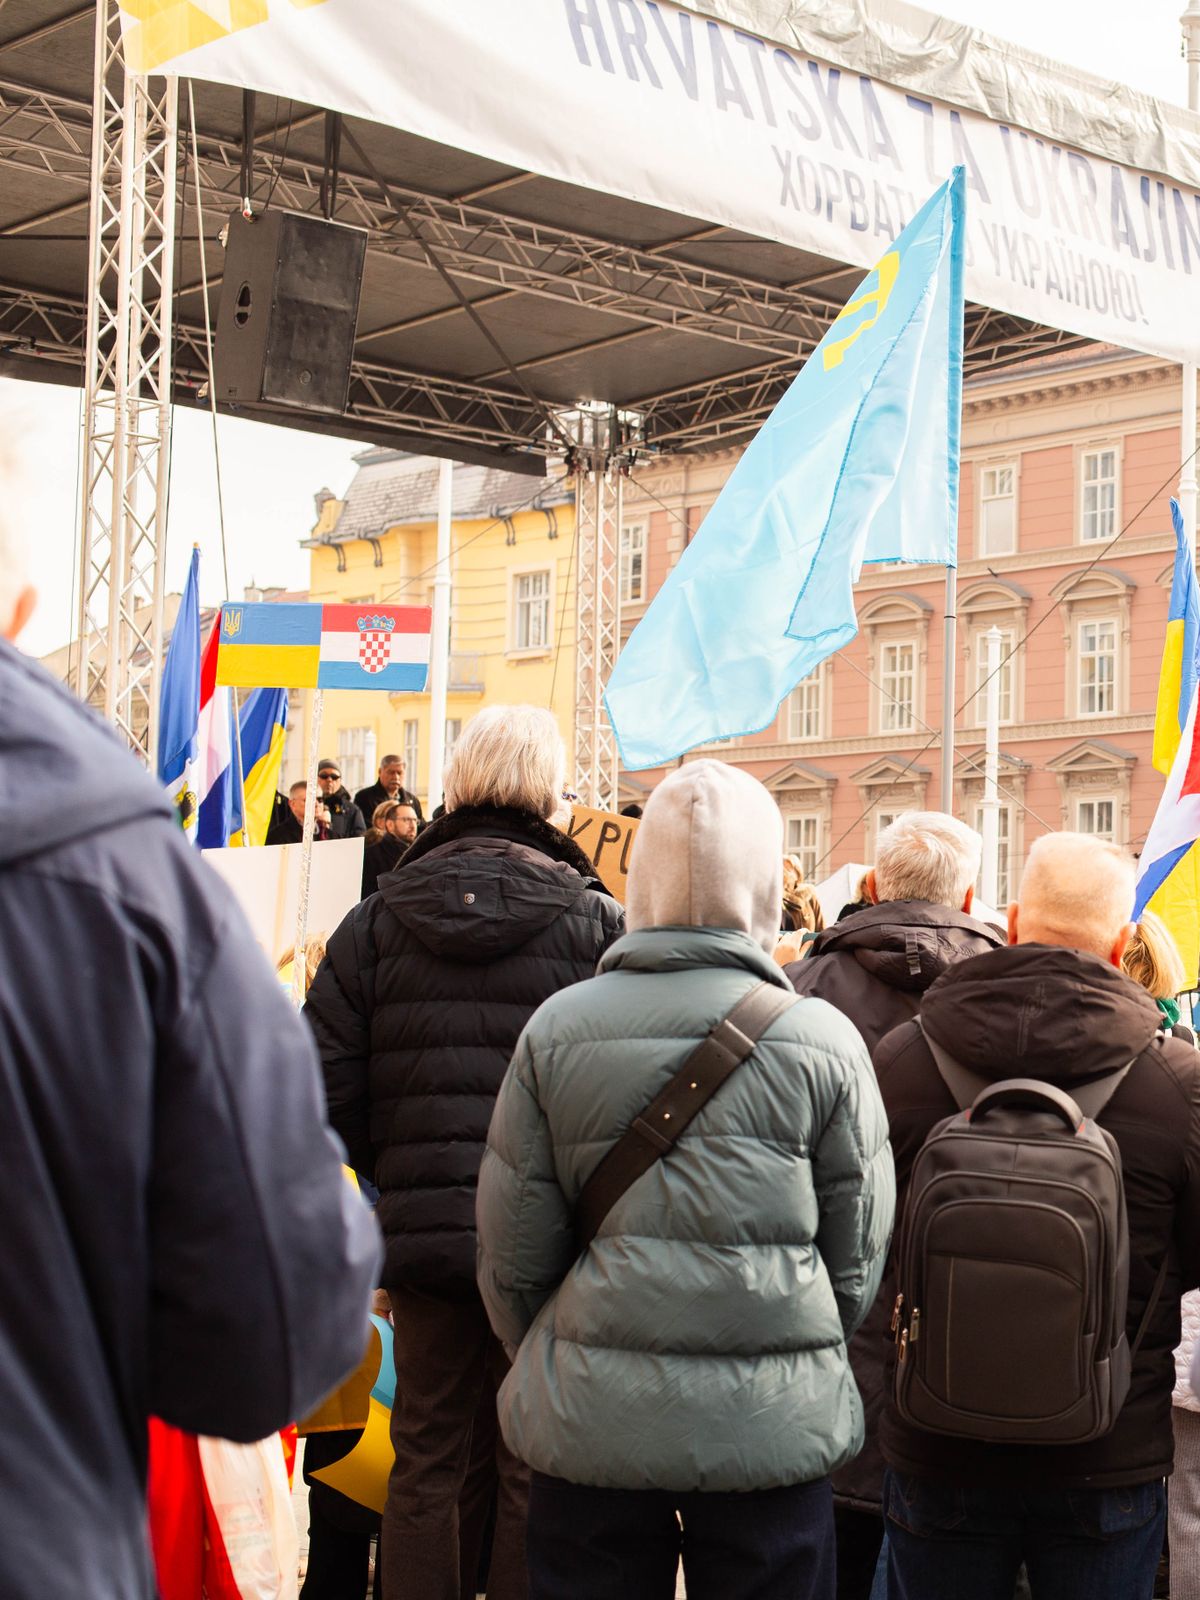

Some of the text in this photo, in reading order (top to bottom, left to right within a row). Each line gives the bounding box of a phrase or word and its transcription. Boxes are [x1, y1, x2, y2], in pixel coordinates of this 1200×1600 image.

[564, 0, 903, 172] HRVATSKA
[905, 94, 991, 205] ZA
[771, 145, 1150, 326] ХОРВАТ УКРАЇНОЮ!
